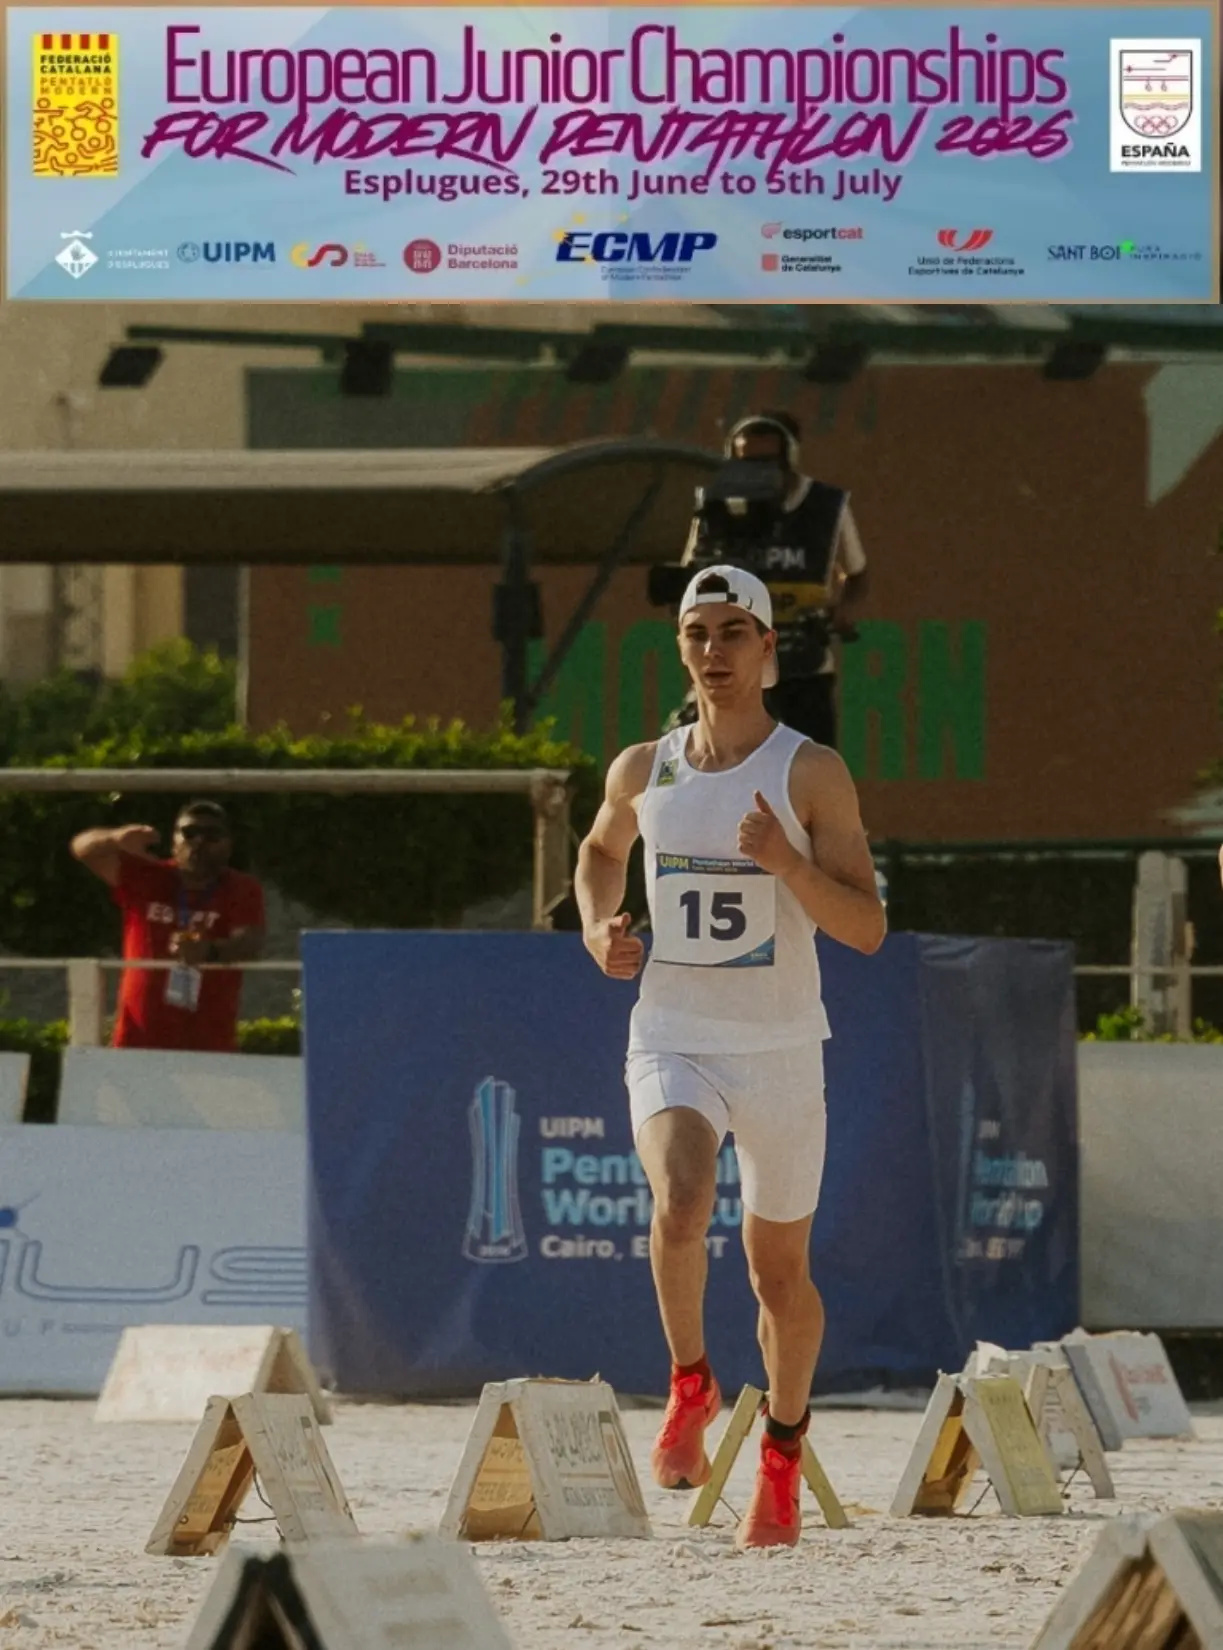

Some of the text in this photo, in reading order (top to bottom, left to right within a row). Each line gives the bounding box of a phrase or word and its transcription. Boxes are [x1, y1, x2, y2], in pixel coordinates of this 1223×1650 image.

[526, 620, 988, 780] MORN
[661, 854, 689, 870] UIPM
[680, 889, 746, 941] 15
[540, 1116, 605, 1138] UIPM
[541, 1187, 655, 1226] Worl
[540, 1233, 624, 1262] Cairo,
